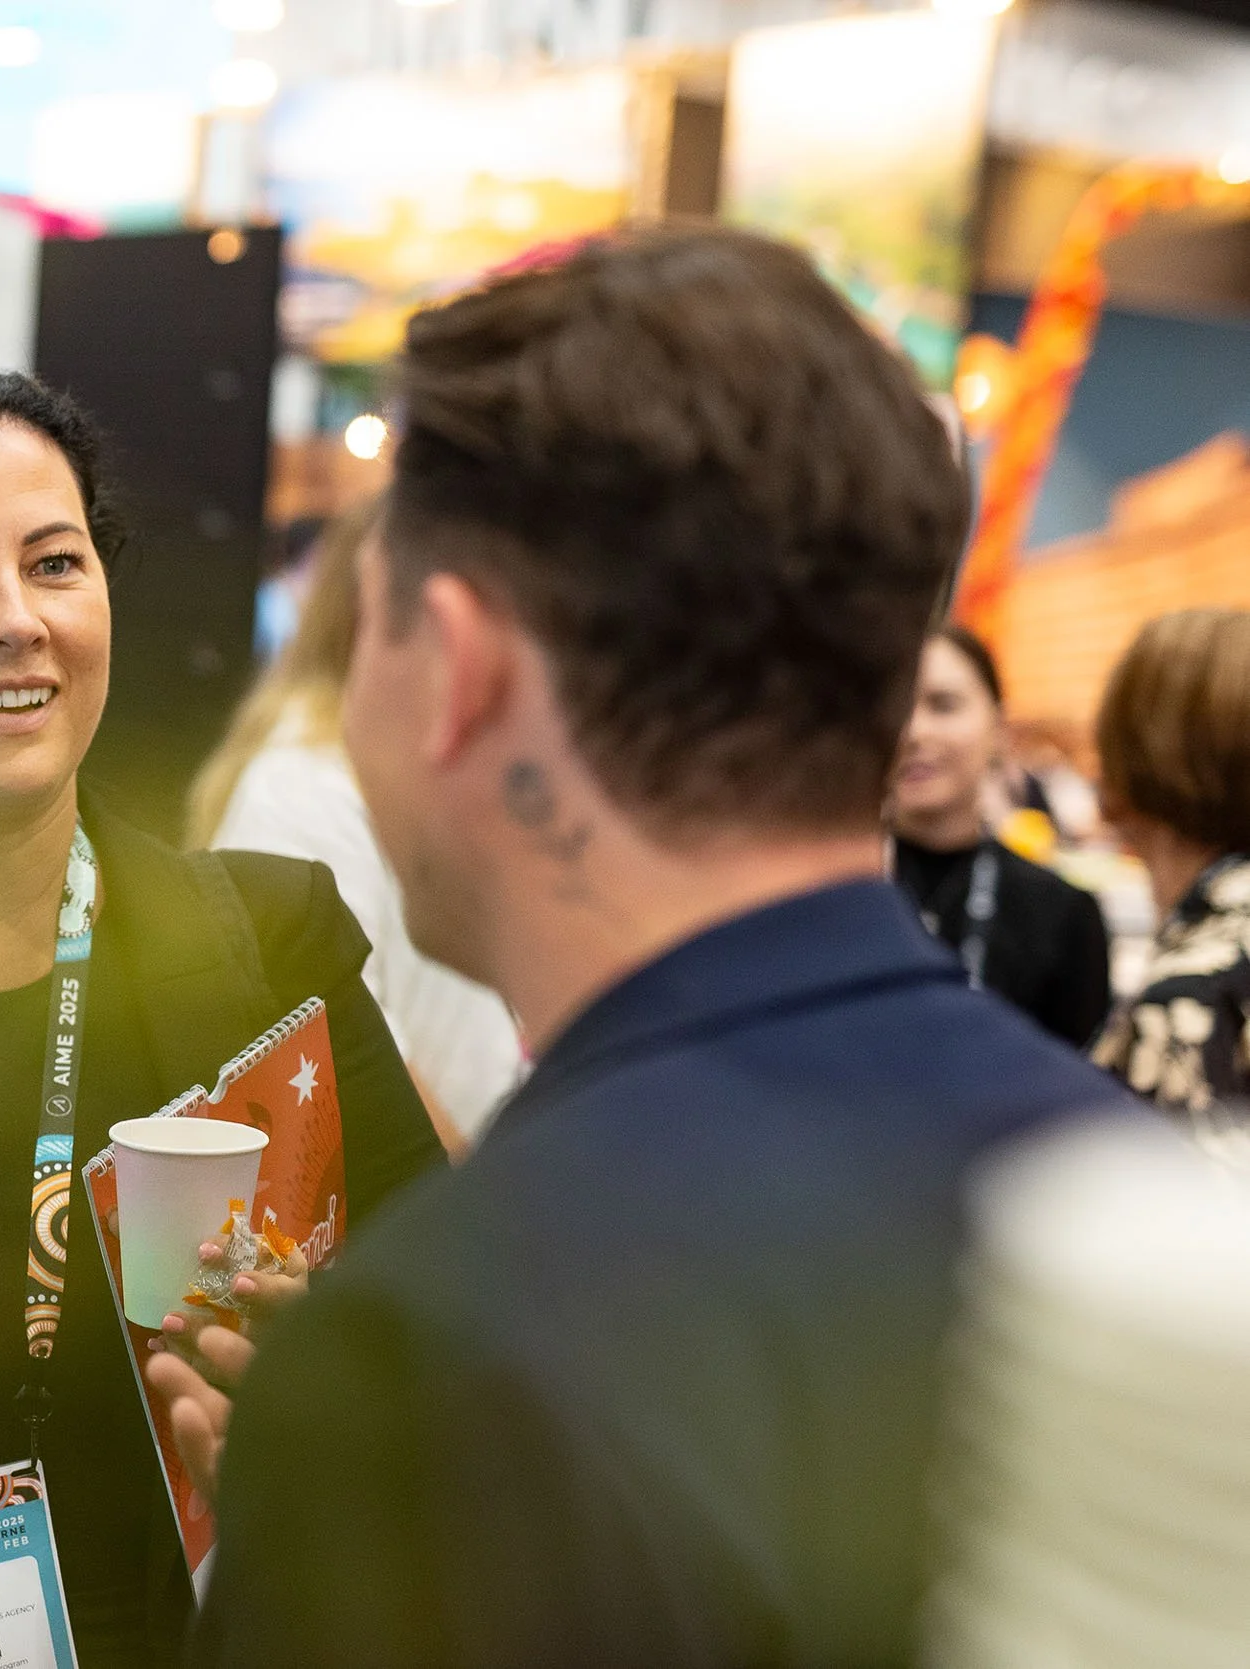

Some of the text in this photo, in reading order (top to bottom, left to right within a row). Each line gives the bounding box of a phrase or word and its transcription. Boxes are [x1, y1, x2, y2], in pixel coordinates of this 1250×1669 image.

[53, 977, 79, 1087] AIME 2025
[4, 1535, 30, 1550] FEB
[4, 1603, 36, 1618] AGENCY
